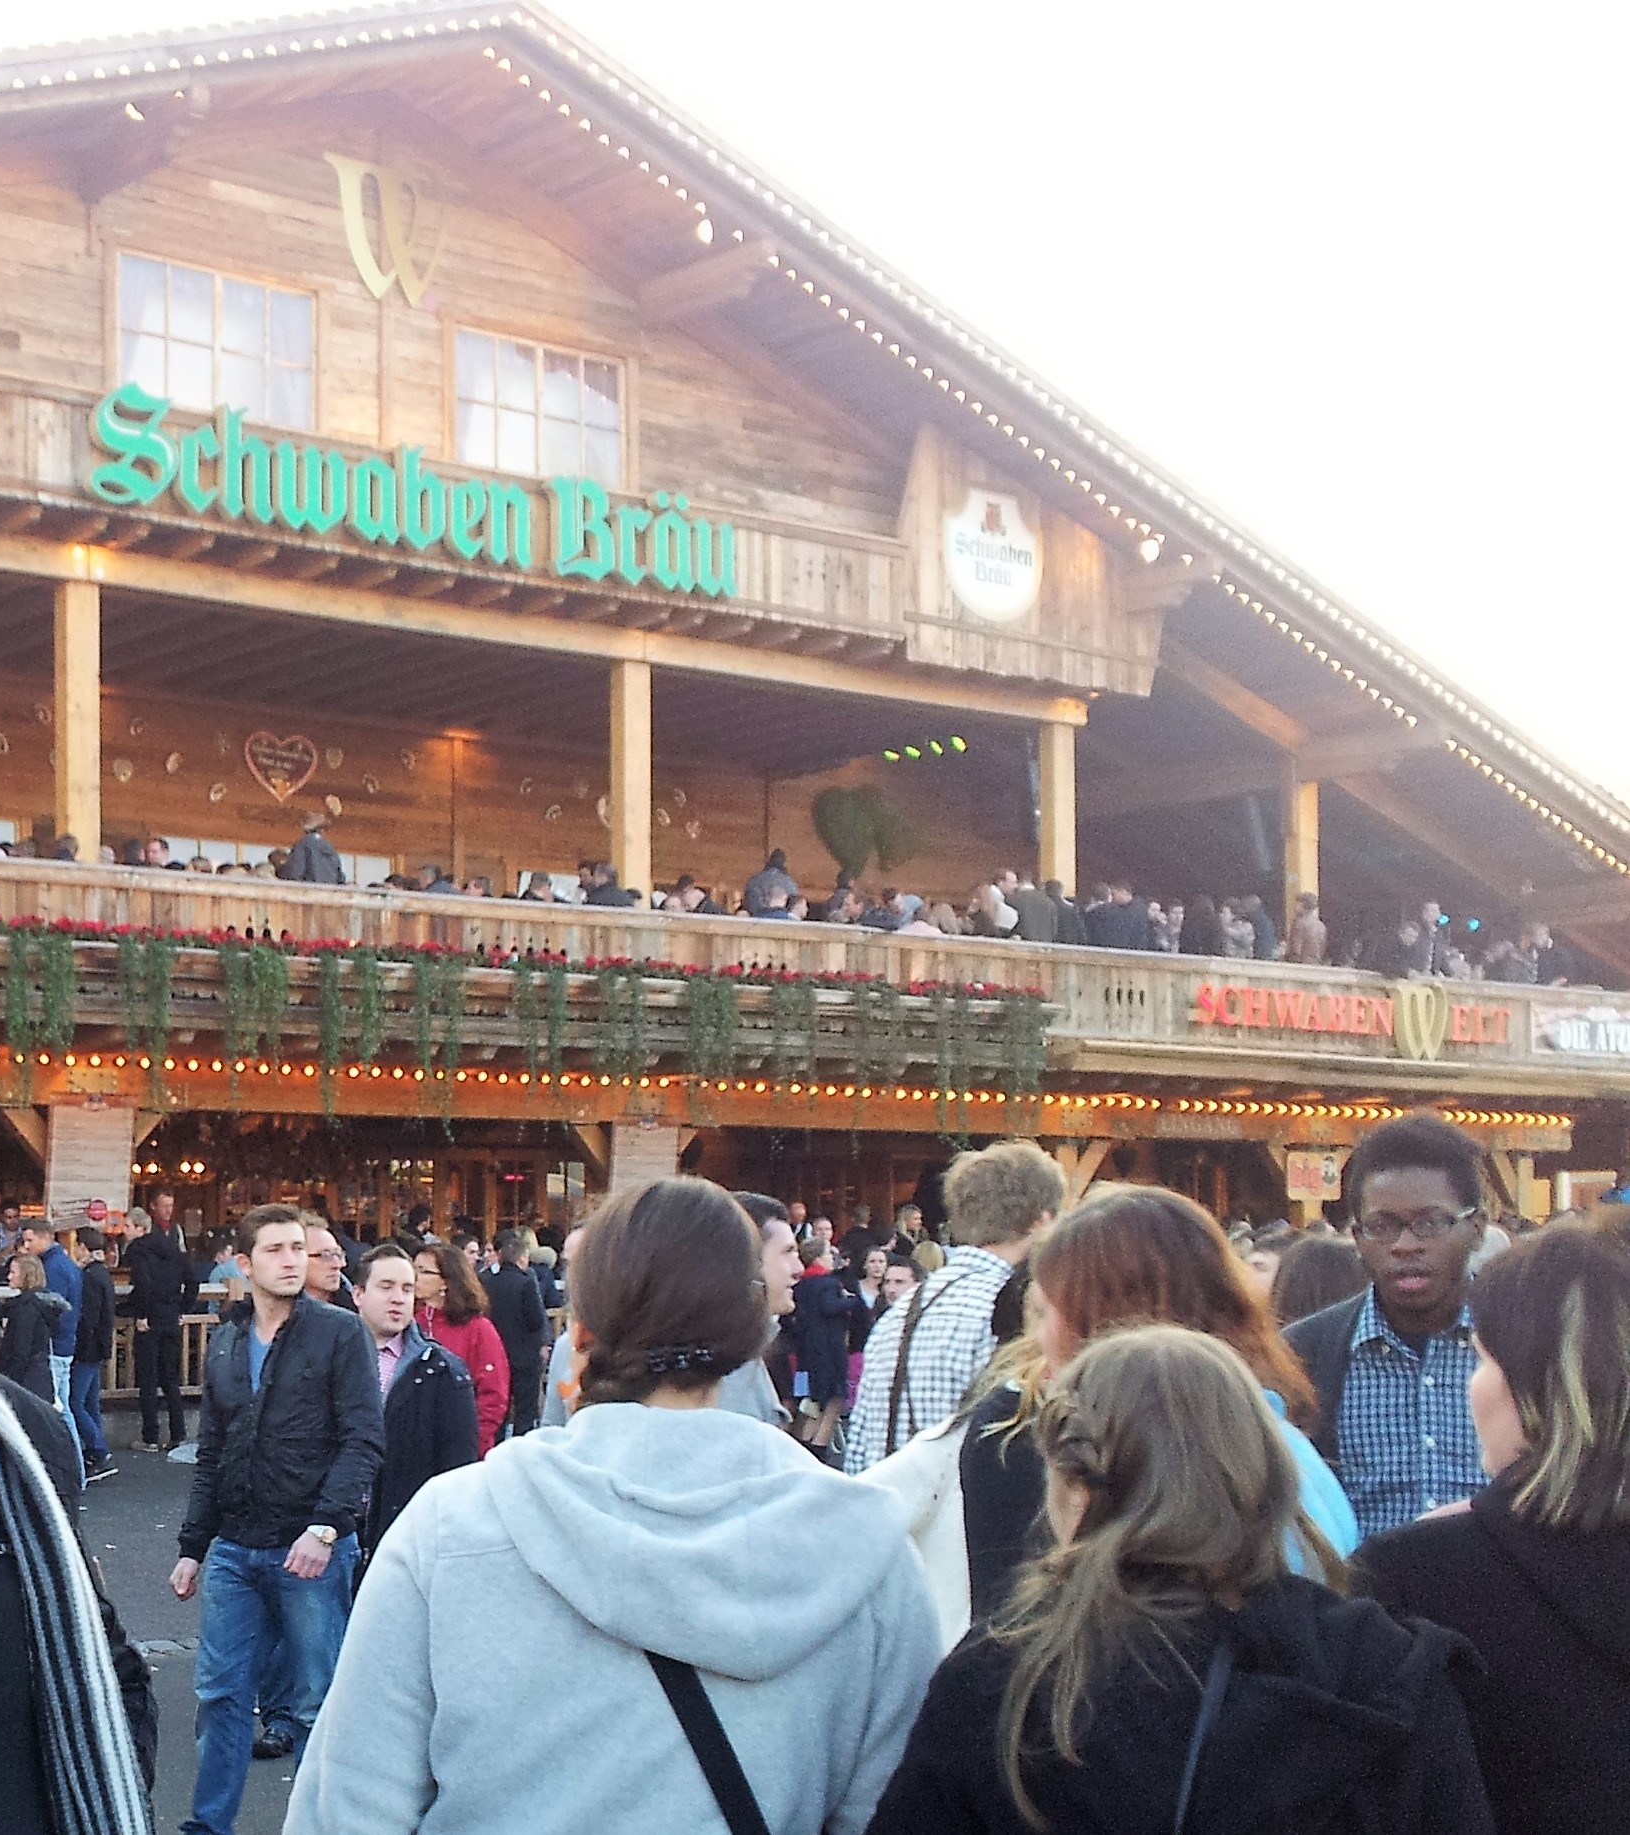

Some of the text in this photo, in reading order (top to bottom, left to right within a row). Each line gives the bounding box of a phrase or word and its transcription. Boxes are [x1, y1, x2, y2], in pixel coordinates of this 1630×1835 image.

[88, 380, 739, 598] Schwaben Bräu
[1196, 978, 1510, 1061] SCHWABEN WELT
